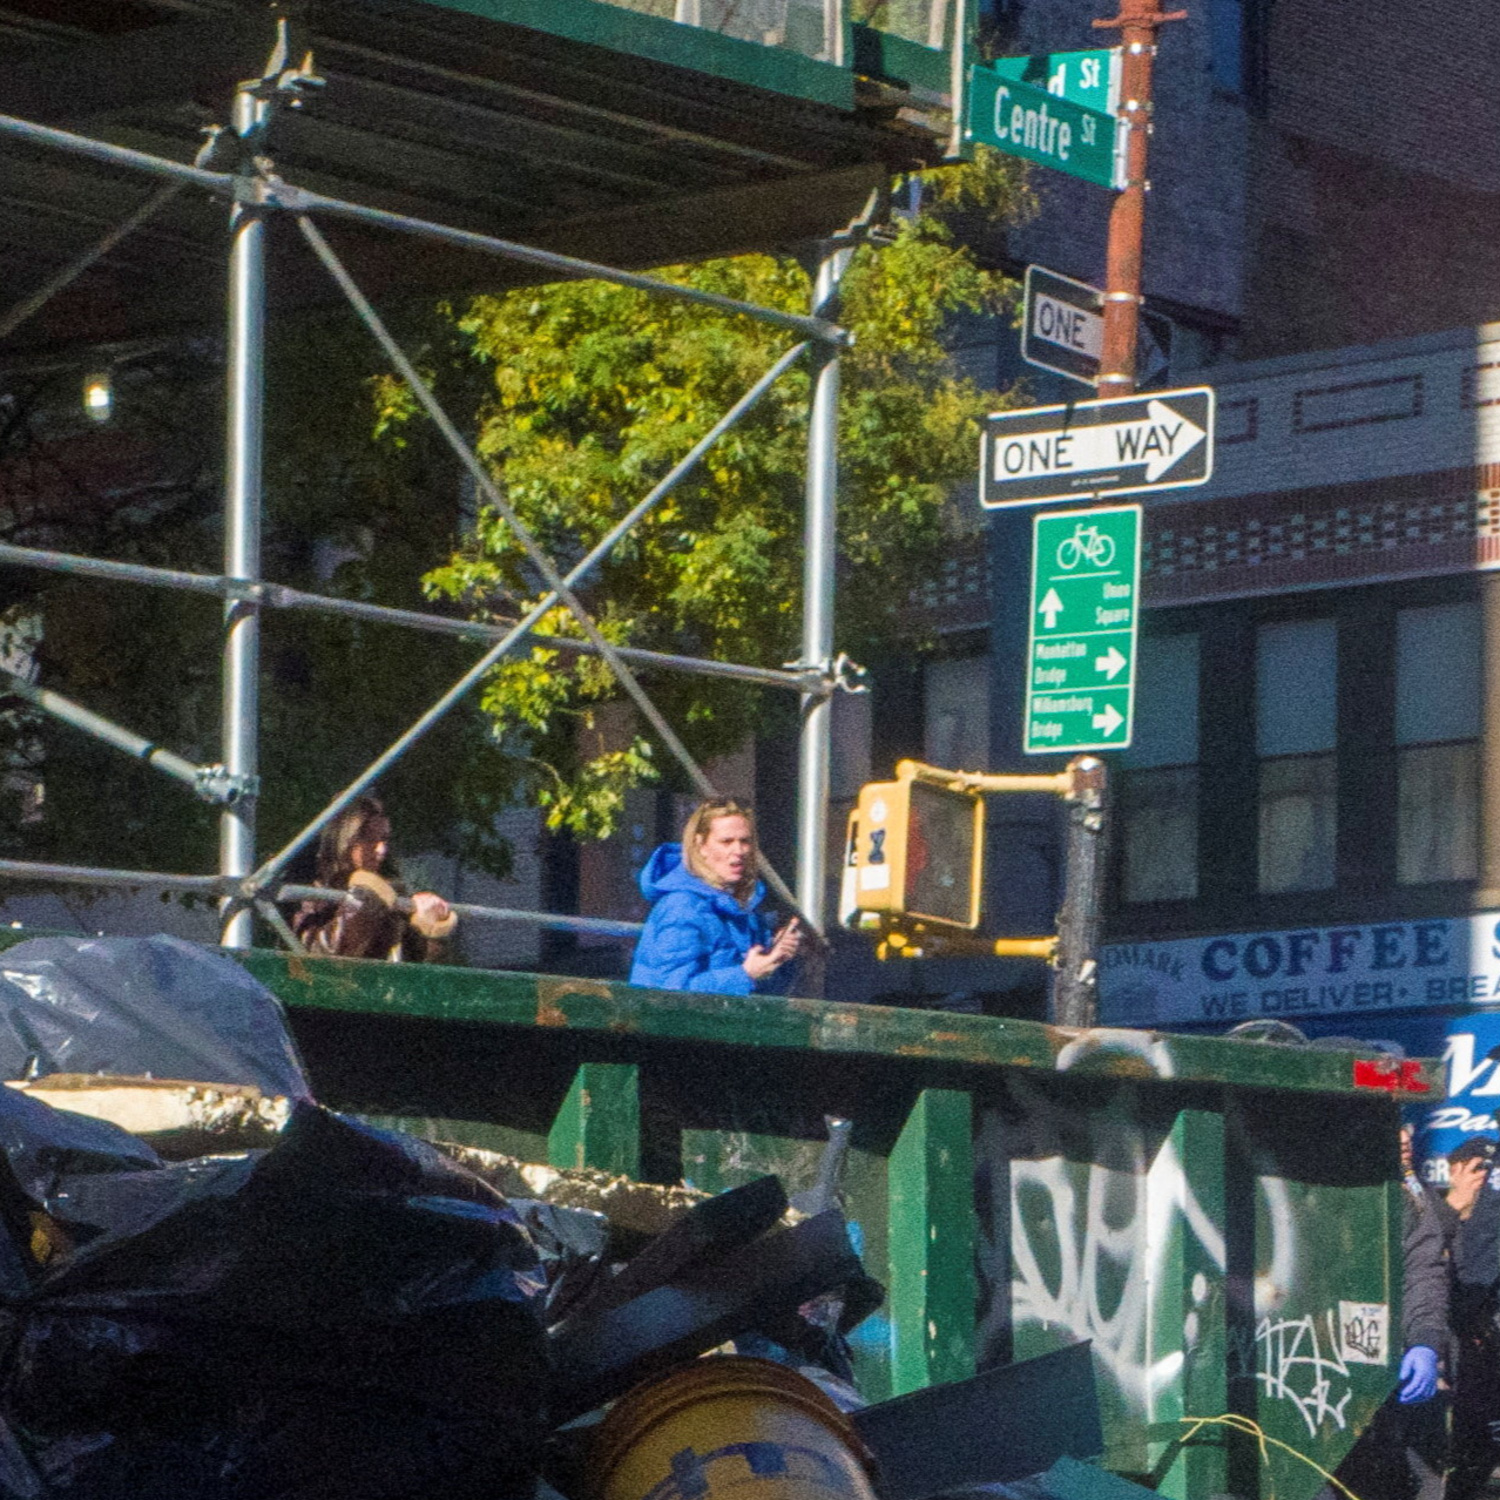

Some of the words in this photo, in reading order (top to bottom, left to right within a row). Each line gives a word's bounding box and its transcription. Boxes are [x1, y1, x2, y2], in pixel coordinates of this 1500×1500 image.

[1080, 58, 1100, 89] St
[993, 87, 1072, 160] Centre
[1081, 114, 1096, 146] St
[1039, 301, 1086, 349] ONE
[1004, 437, 1073, 474] ONE
[1116, 421, 1183, 462] WAY
[1201, 923, 1451, 982] COFFEE
[1202, 993, 1248, 1016] WE
[1261, 981, 1393, 1011] DELIVER
